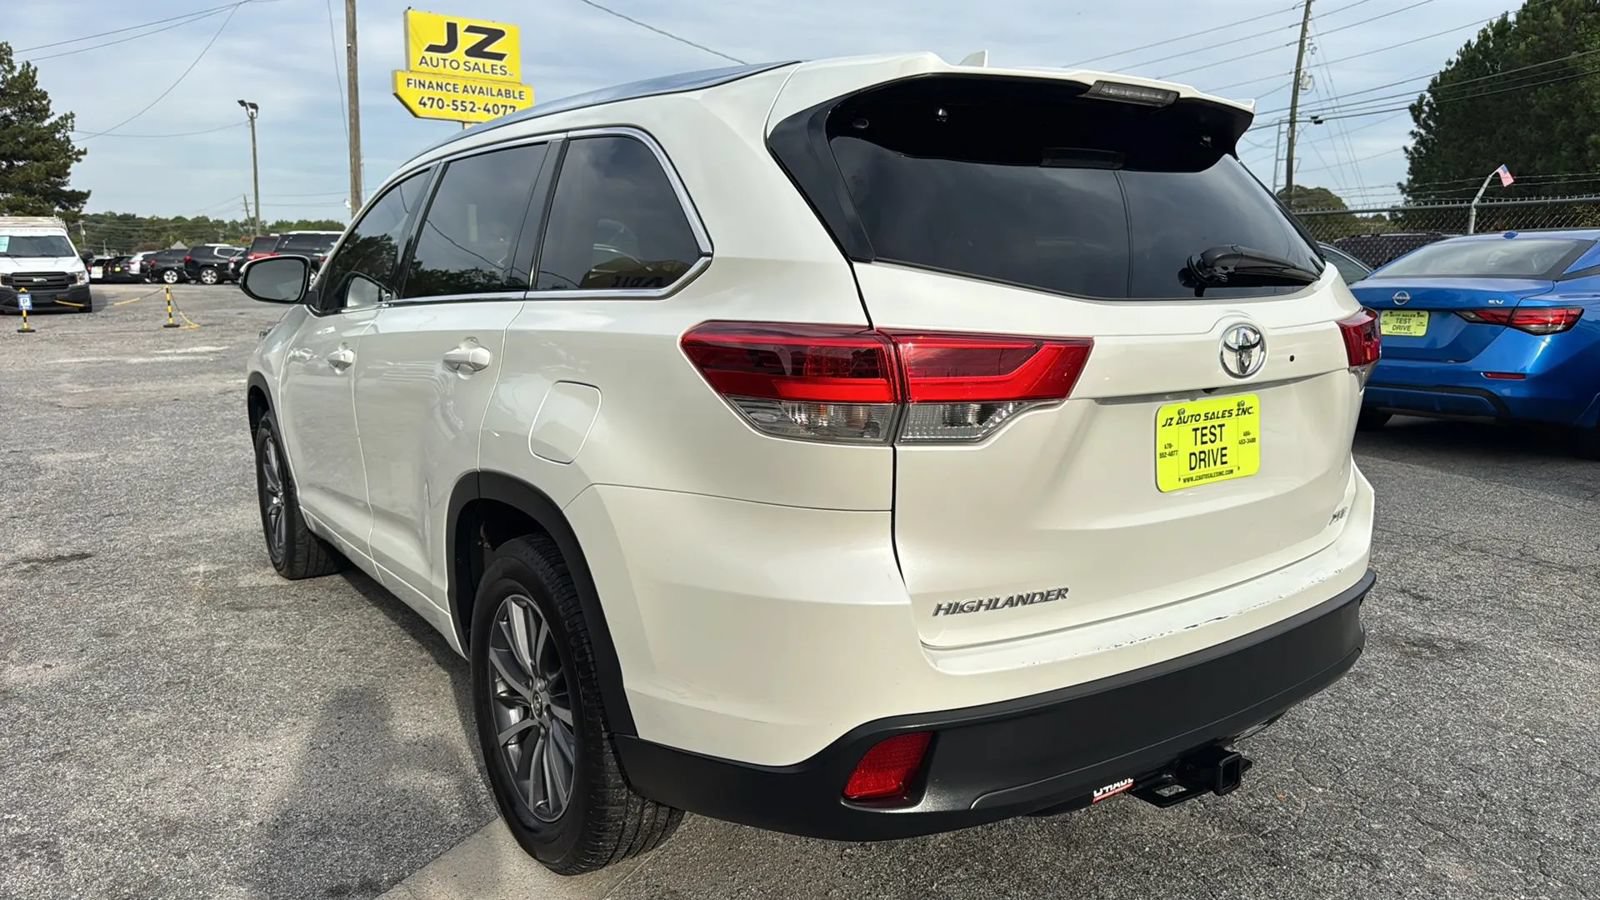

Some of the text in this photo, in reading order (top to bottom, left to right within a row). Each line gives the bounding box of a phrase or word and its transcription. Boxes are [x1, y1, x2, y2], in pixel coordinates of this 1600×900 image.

[424, 22, 508, 61] JZ
[418, 55, 508, 76] AUTO SALES
[406, 78, 525, 100] FINANCE AVAILABLE
[418, 96, 517, 116] 470-552-4077
[1161, 416, 1174, 427] JZ
[1176, 413, 1201, 425] AUTO
[1203, 408, 1233, 420] SALES
[1192, 423, 1225, 446] TEST
[1189, 447, 1228, 471] DRIVE
[932, 587, 1069, 617] HIGHLANDER
